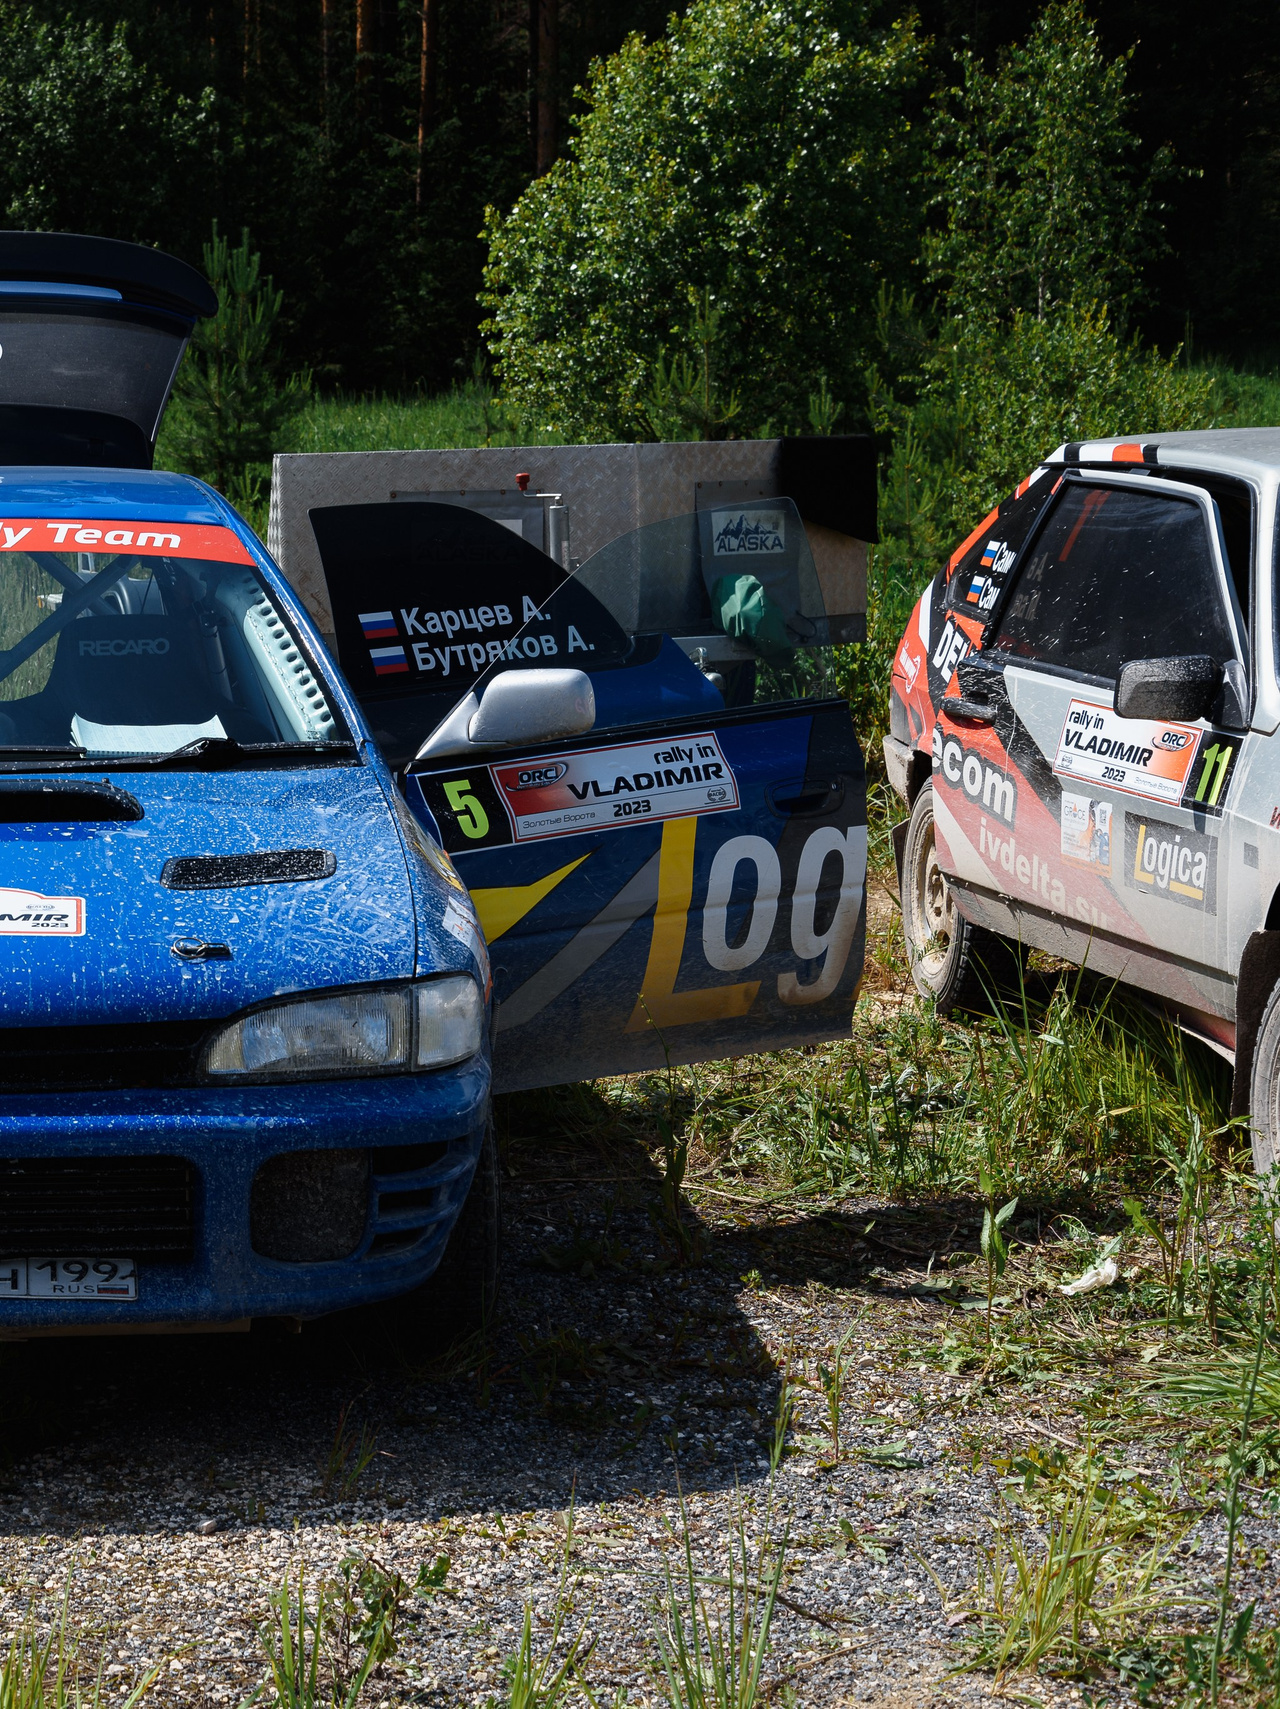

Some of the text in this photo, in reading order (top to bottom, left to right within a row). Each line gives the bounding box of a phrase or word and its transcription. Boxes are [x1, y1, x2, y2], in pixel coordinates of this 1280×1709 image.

[51, 523, 182, 549] Team
[716, 535, 784, 553] ALASKA
[399, 595, 552, 637] Карцев А.
[79, 637, 170, 656] RECARO
[412, 624, 596, 677] Бутряков А.
[1068, 709, 1105, 731] rally in
[1064, 729, 1154, 767] VLADIMIR
[1161, 732, 1186, 746] ORC
[654, 743, 717, 765] rally in
[519, 768, 556, 783] ORC
[567, 762, 724, 800] VLADIMIR
[1101, 766, 1126, 783] 2023
[1194, 743, 1233, 806] 11
[442, 779, 490, 839] 5
[613, 799, 652, 818] 2023
[523, 811, 596, 829] Золотые Ворота
[1134, 824, 1208, 890] Logica
[624, 816, 868, 1034] Log
[33, 1260, 121, 1283] 199
[52, 1284, 95, 1294] RUS
